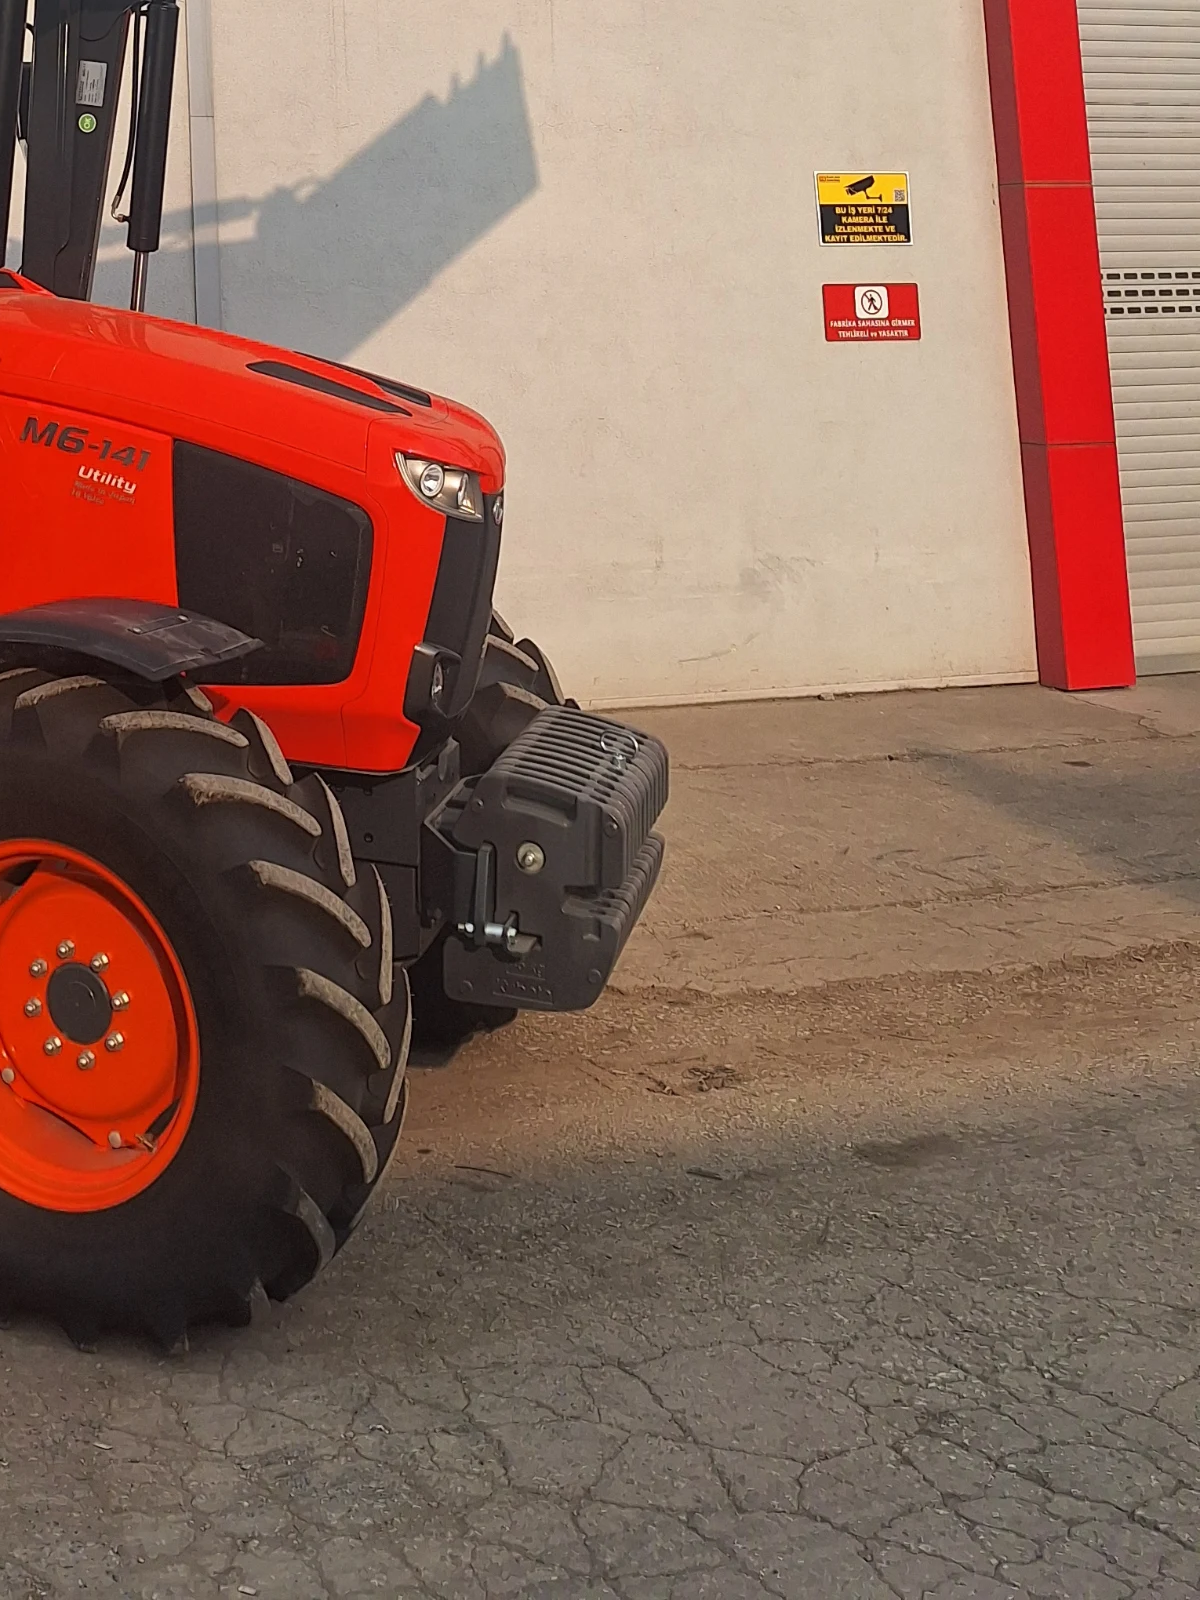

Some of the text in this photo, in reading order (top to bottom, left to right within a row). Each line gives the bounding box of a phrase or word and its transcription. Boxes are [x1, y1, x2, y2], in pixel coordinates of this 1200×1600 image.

[848, 205, 856, 215] İŞ
[857, 205, 875, 213] YERİ
[875, 215, 888, 223] İLE
[835, 224, 883, 233] İZLENMEKTE
[850, 233, 907, 242] EDİLMEKTEDİR.
[830, 318, 915, 328] FABRİKA SAHASINA GİRMEK
[838, 329, 869, 338] TEHLİKELİ
[19, 416, 152, 472] M6-141
[78, 465, 137, 494] Utility
